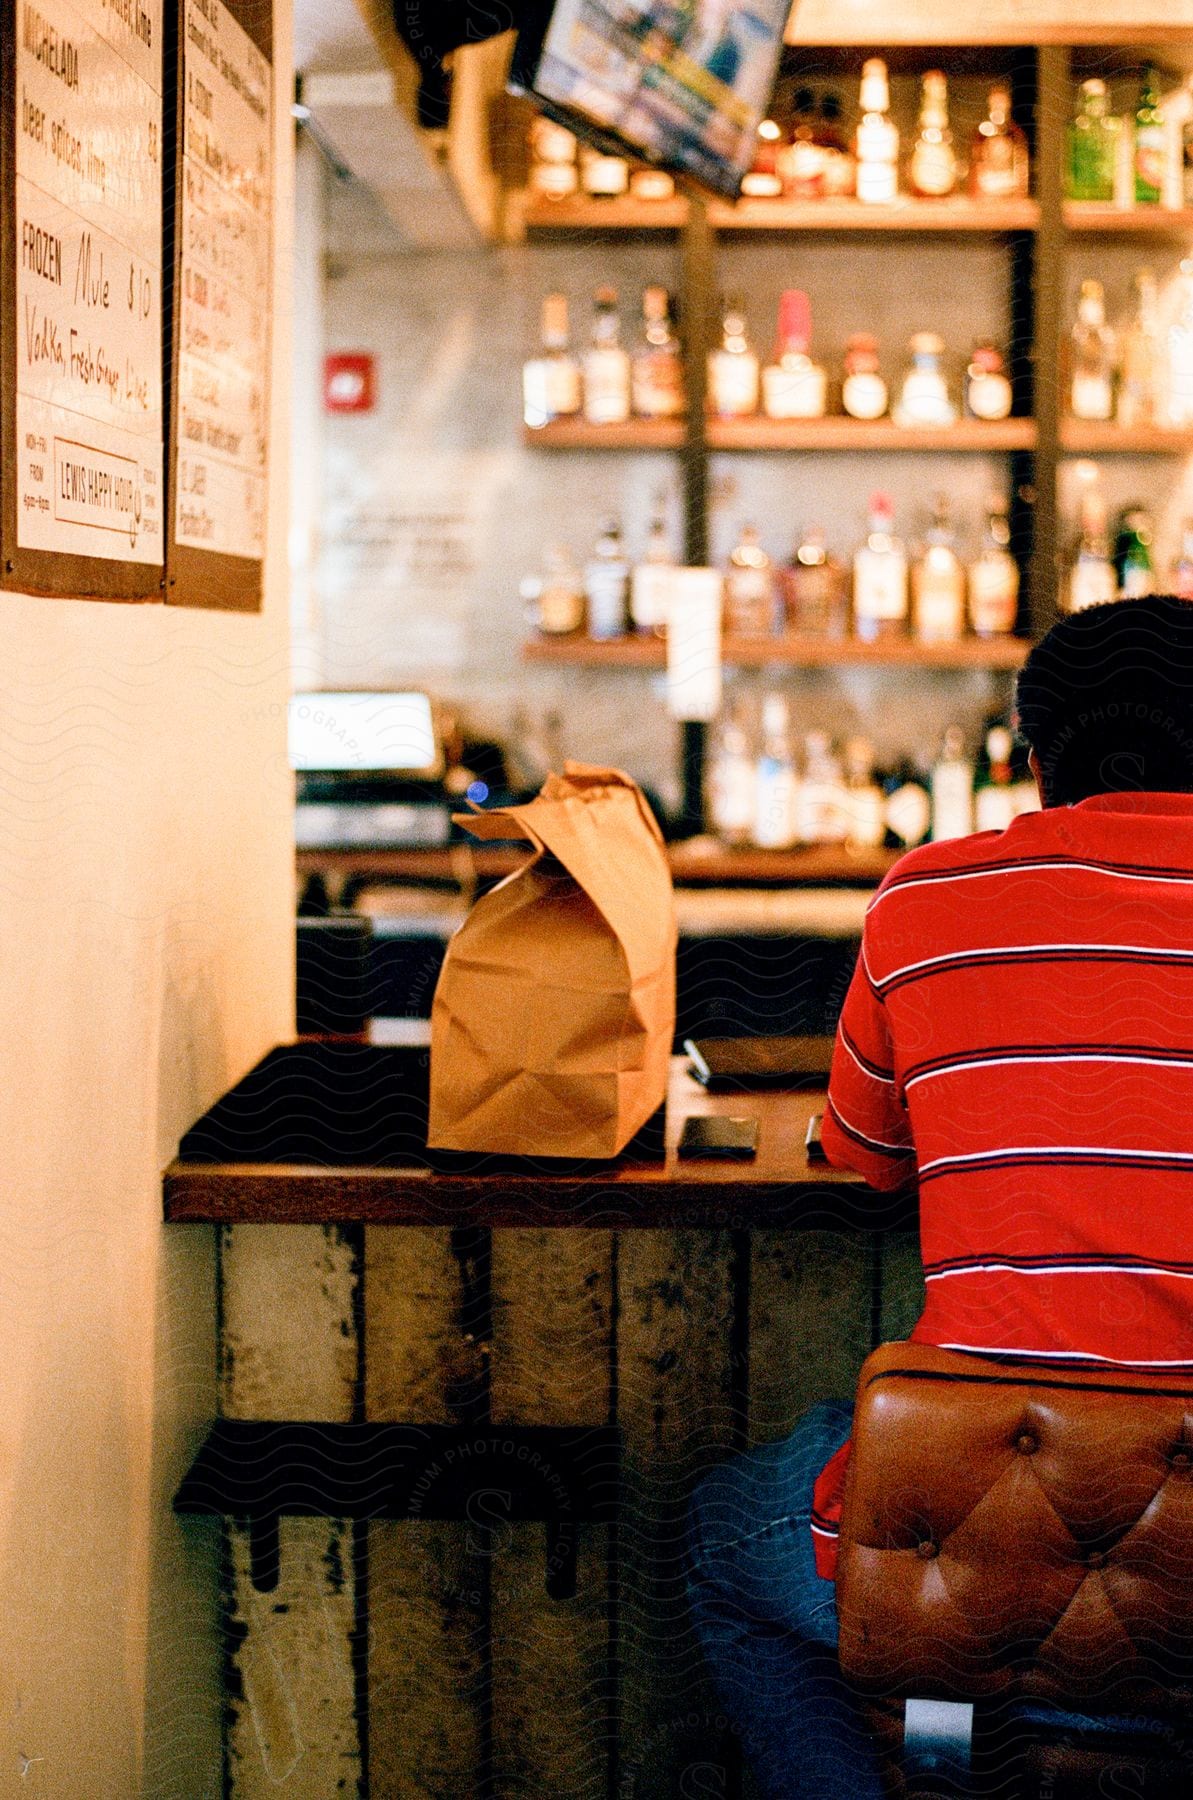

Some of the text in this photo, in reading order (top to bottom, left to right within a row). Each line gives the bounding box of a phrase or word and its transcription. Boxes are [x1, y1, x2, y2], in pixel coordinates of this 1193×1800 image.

[22, 219, 62, 286] FROZEN
[74, 231, 110, 309] Mule
[70, 328, 94, 385] Fresh
[61, 461, 86, 503] LEWIS
[88, 468, 113, 510] HAPPY
